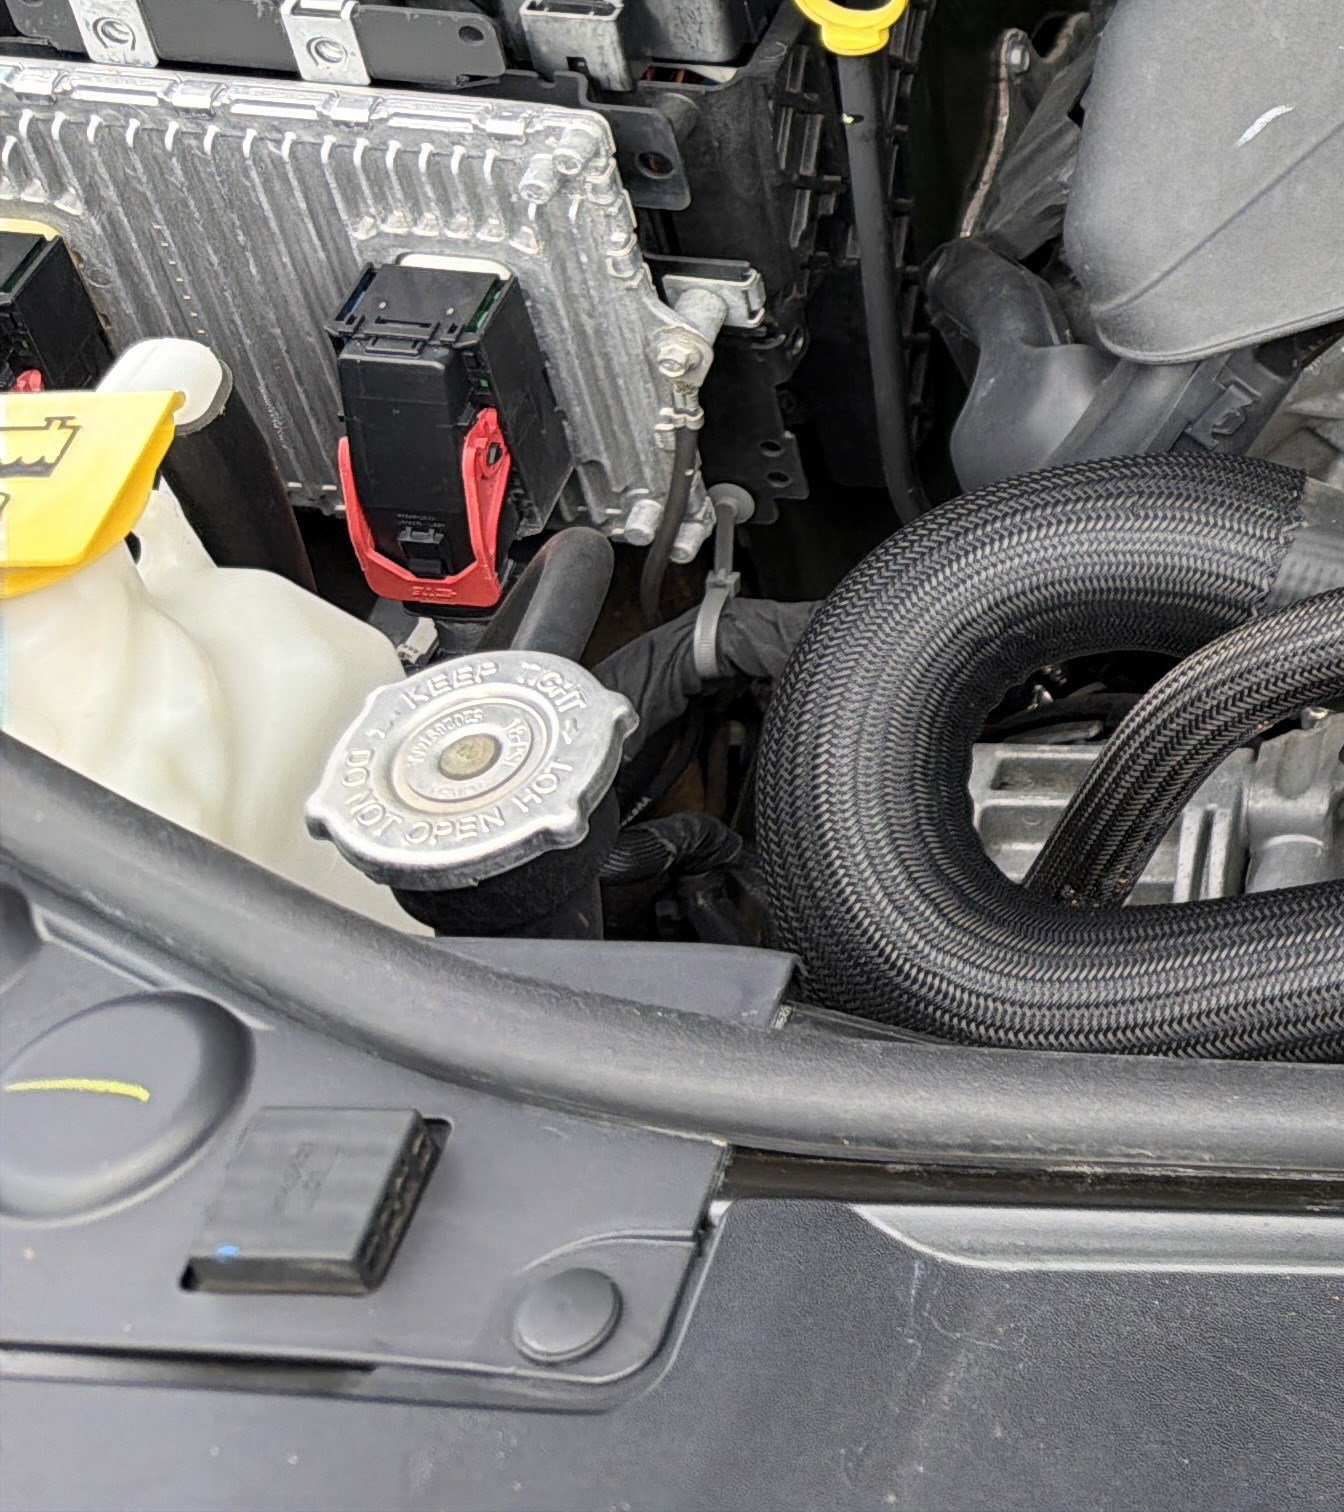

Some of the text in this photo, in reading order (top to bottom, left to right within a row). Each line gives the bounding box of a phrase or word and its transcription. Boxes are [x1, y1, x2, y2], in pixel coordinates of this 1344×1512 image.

[401, 661, 499, 709] KEEP
[342, 747, 375, 787] DO
[514, 759, 573, 813] HOT
[346, 792, 403, 838] NOT
[404, 807, 507, 846] OPEN
